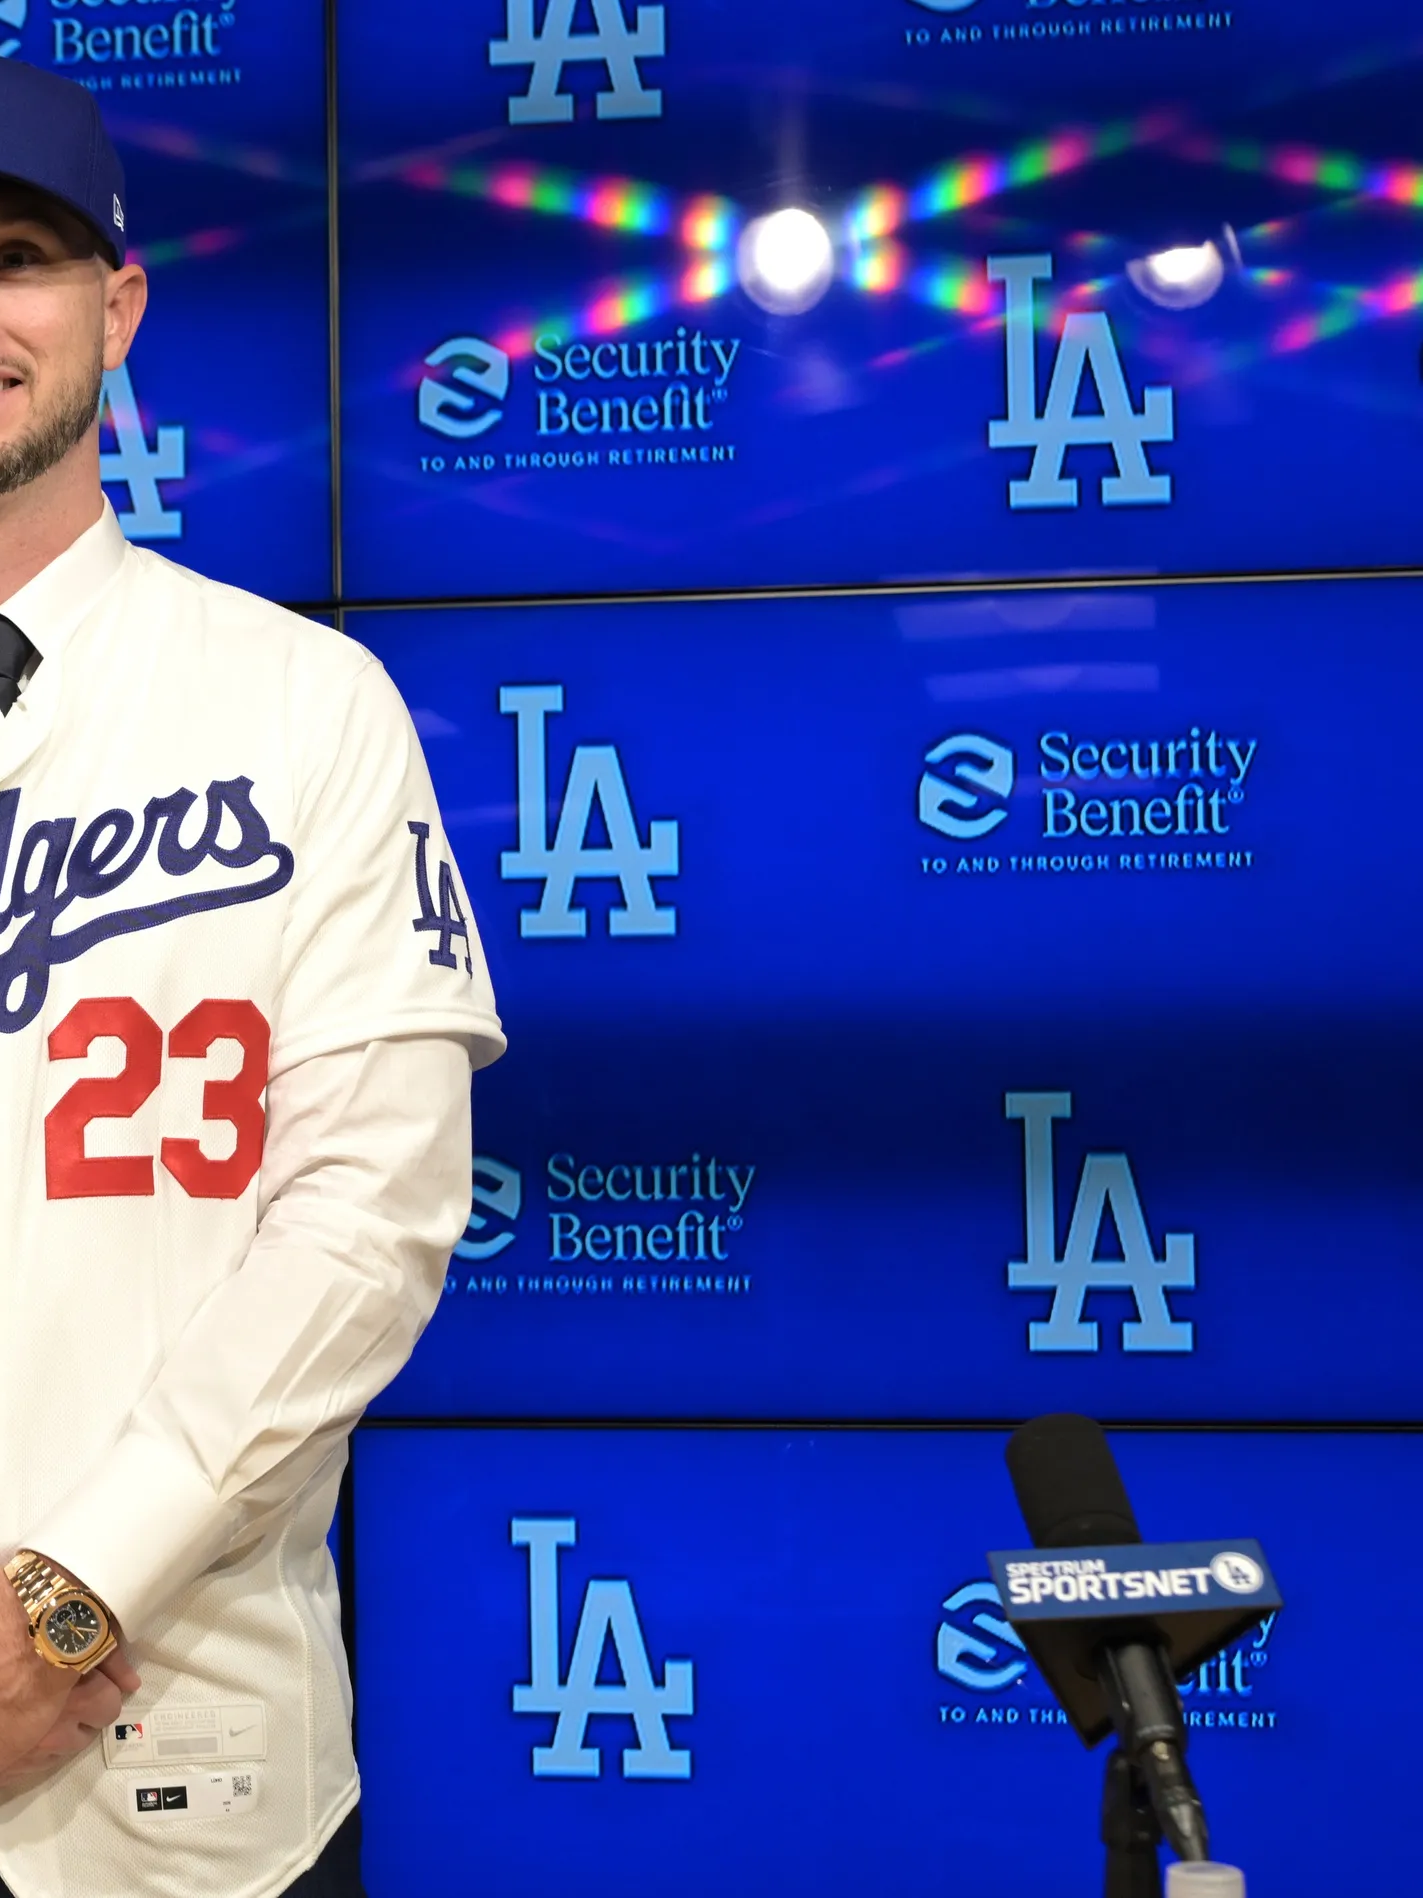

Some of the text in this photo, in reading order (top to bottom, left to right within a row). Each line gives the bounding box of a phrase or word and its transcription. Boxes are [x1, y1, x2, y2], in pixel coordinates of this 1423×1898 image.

[905, 11, 1232, 45] TO AND THROUGH RETIREMENT
[121, 67, 242, 90] RETIREMENT
[534, 326, 740, 386] Security
[987, 253, 1173, 509] LA
[420, 445, 735, 471] TO AND THROUGH RETIREMENT
[1040, 726, 1257, 784] Security
[499, 683, 679, 938] LA
[921, 852, 1253, 873] TO AND THROUGH RETIREMENT
[407, 821, 473, 979] LA
[45, 996, 271, 1200] 23
[548, 1152, 756, 1213] Security
[1005, 1090, 1196, 1353] LA
[444, 1274, 752, 1293] O AND THROUGH RETIREMENT
[1005, 1559, 1106, 1578] SPECTRUM
[1008, 1567, 1212, 1605] SPORTSNET
[511, 1517, 693, 1779] LA
[940, 1706, 965, 1723] TO
[976, 1706, 1019, 1724] AND
[1183, 1711, 1276, 1728] IREMENT
